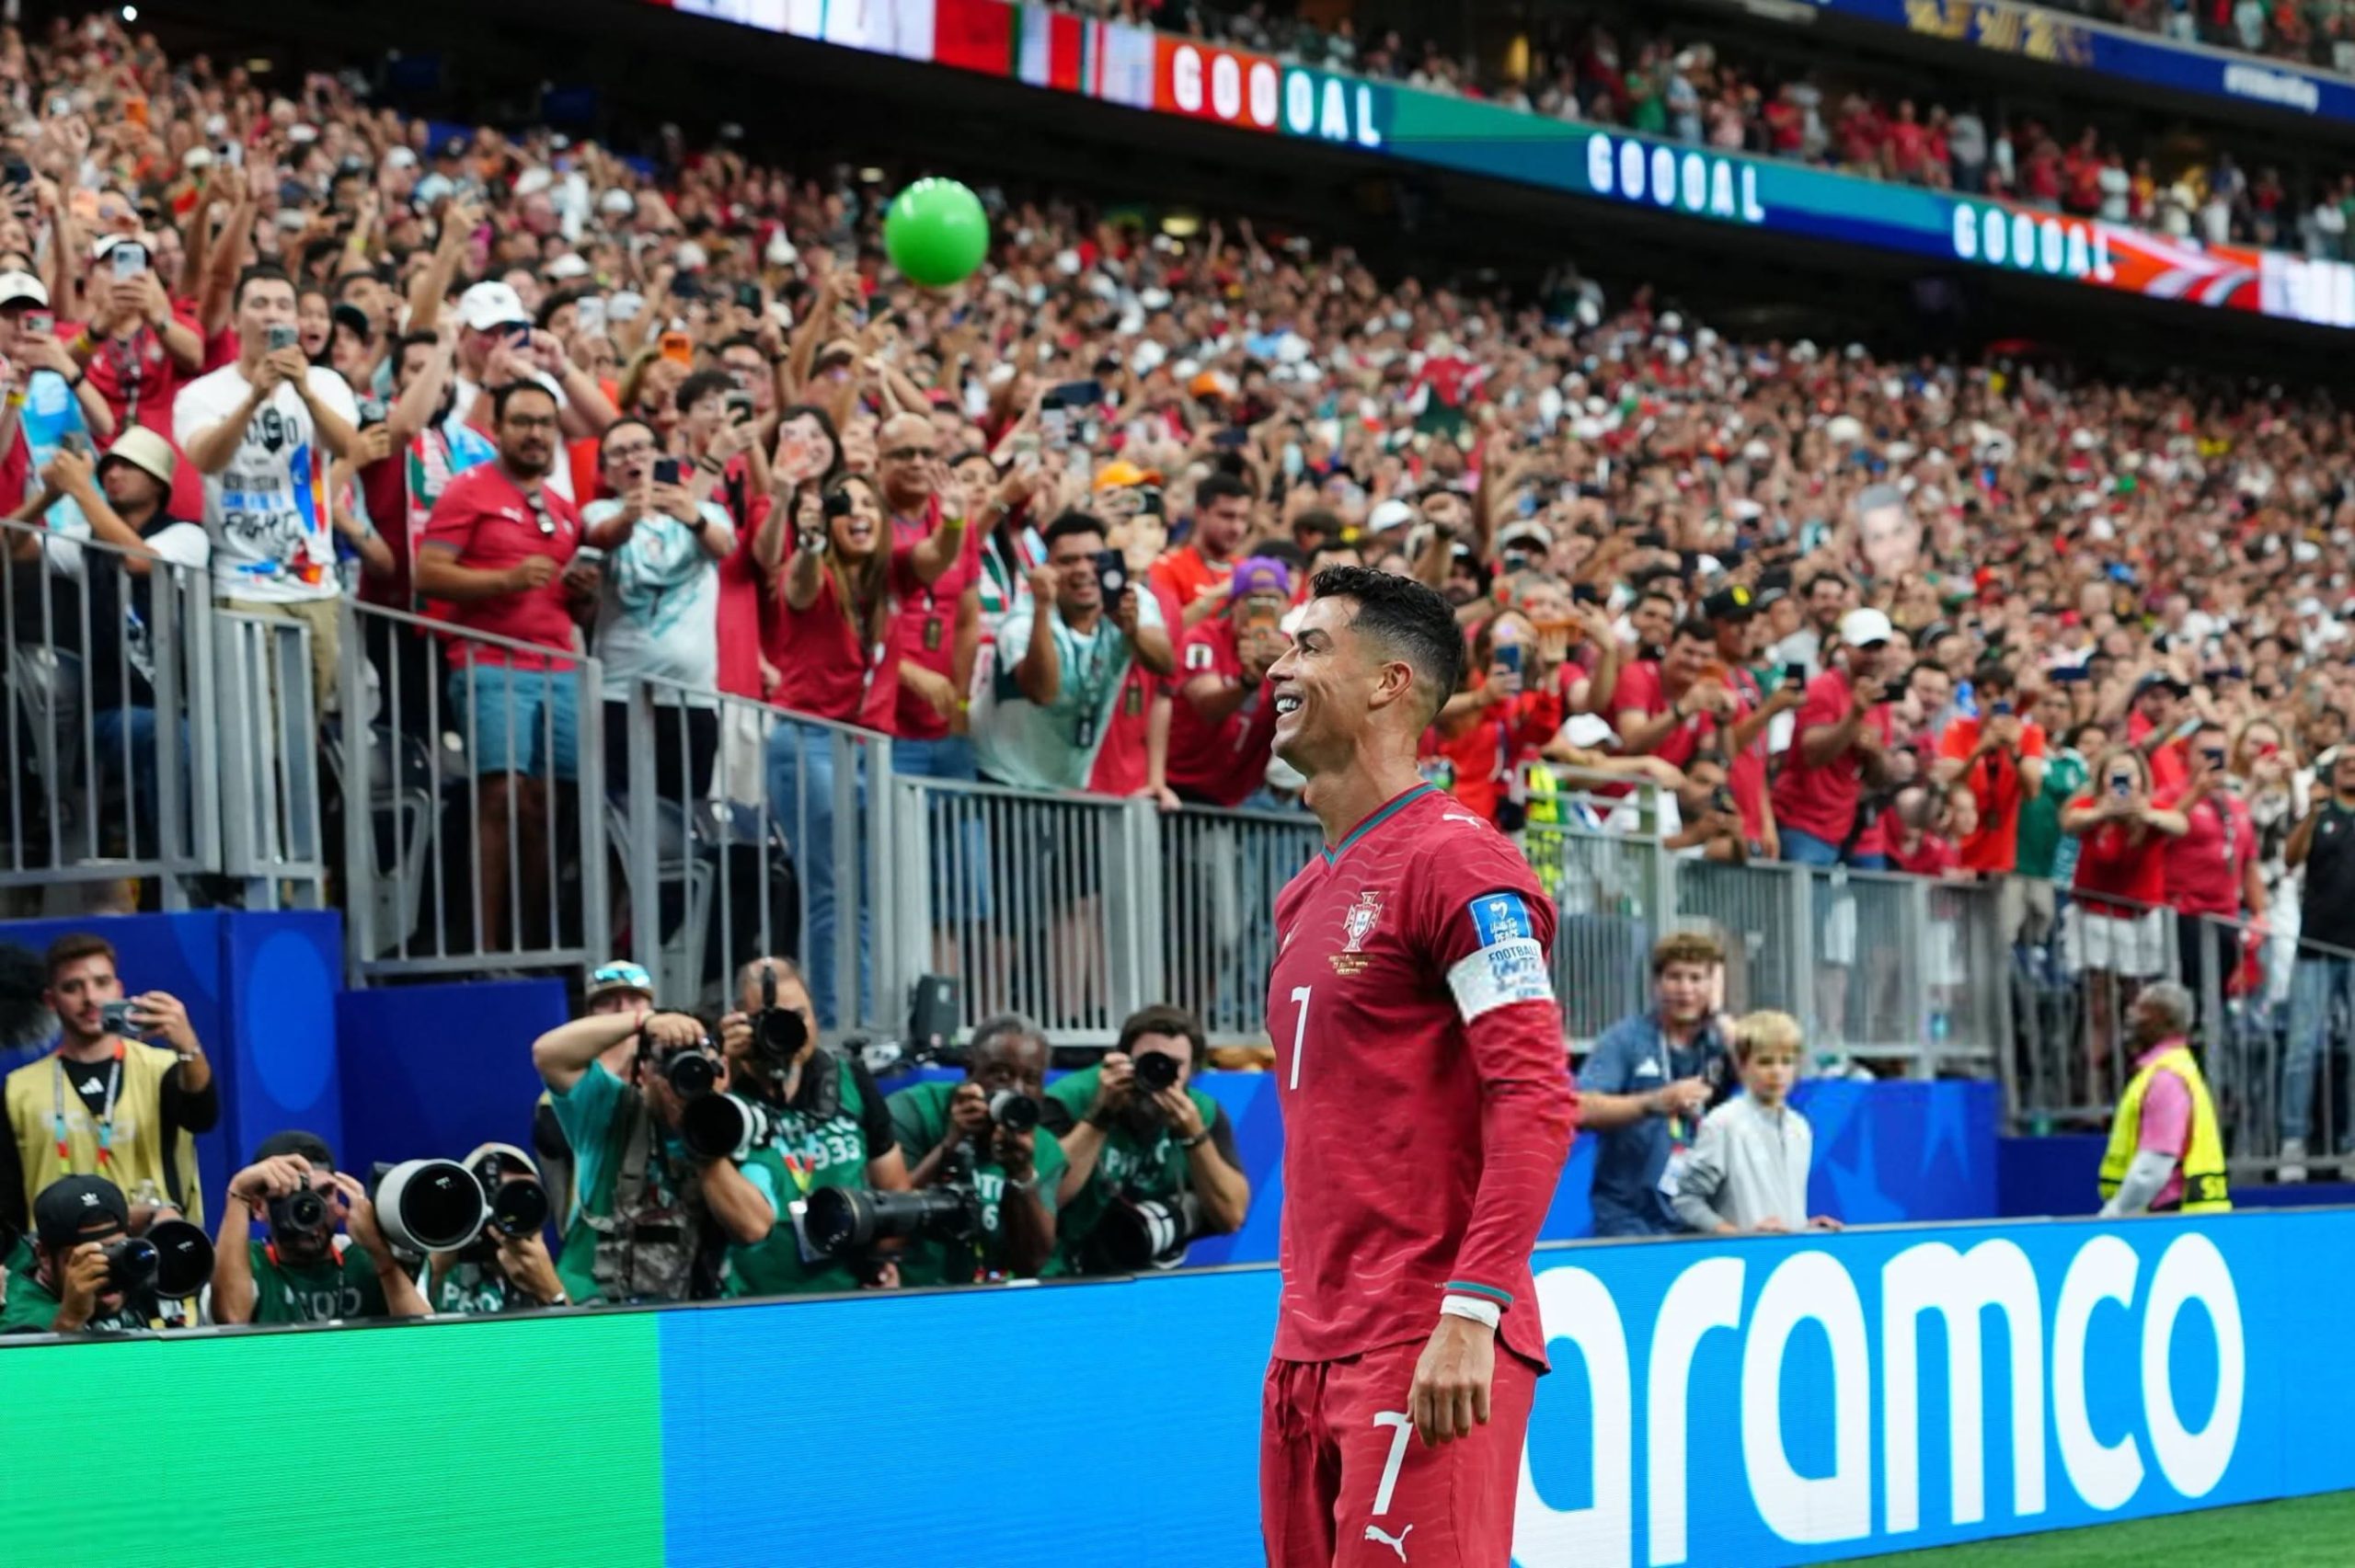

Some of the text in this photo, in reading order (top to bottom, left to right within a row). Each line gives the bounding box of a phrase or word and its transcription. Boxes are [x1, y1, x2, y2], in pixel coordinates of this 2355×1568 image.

[1173, 45, 1381, 147] GOOOAL
[1588, 132, 1765, 223] GOOOAL
[1953, 202, 2115, 282] GOOOAL
[1290, 984, 1312, 1091] 7
[1511, 1232, 2246, 1568] aramco
[1372, 1411, 1414, 1516] 7
